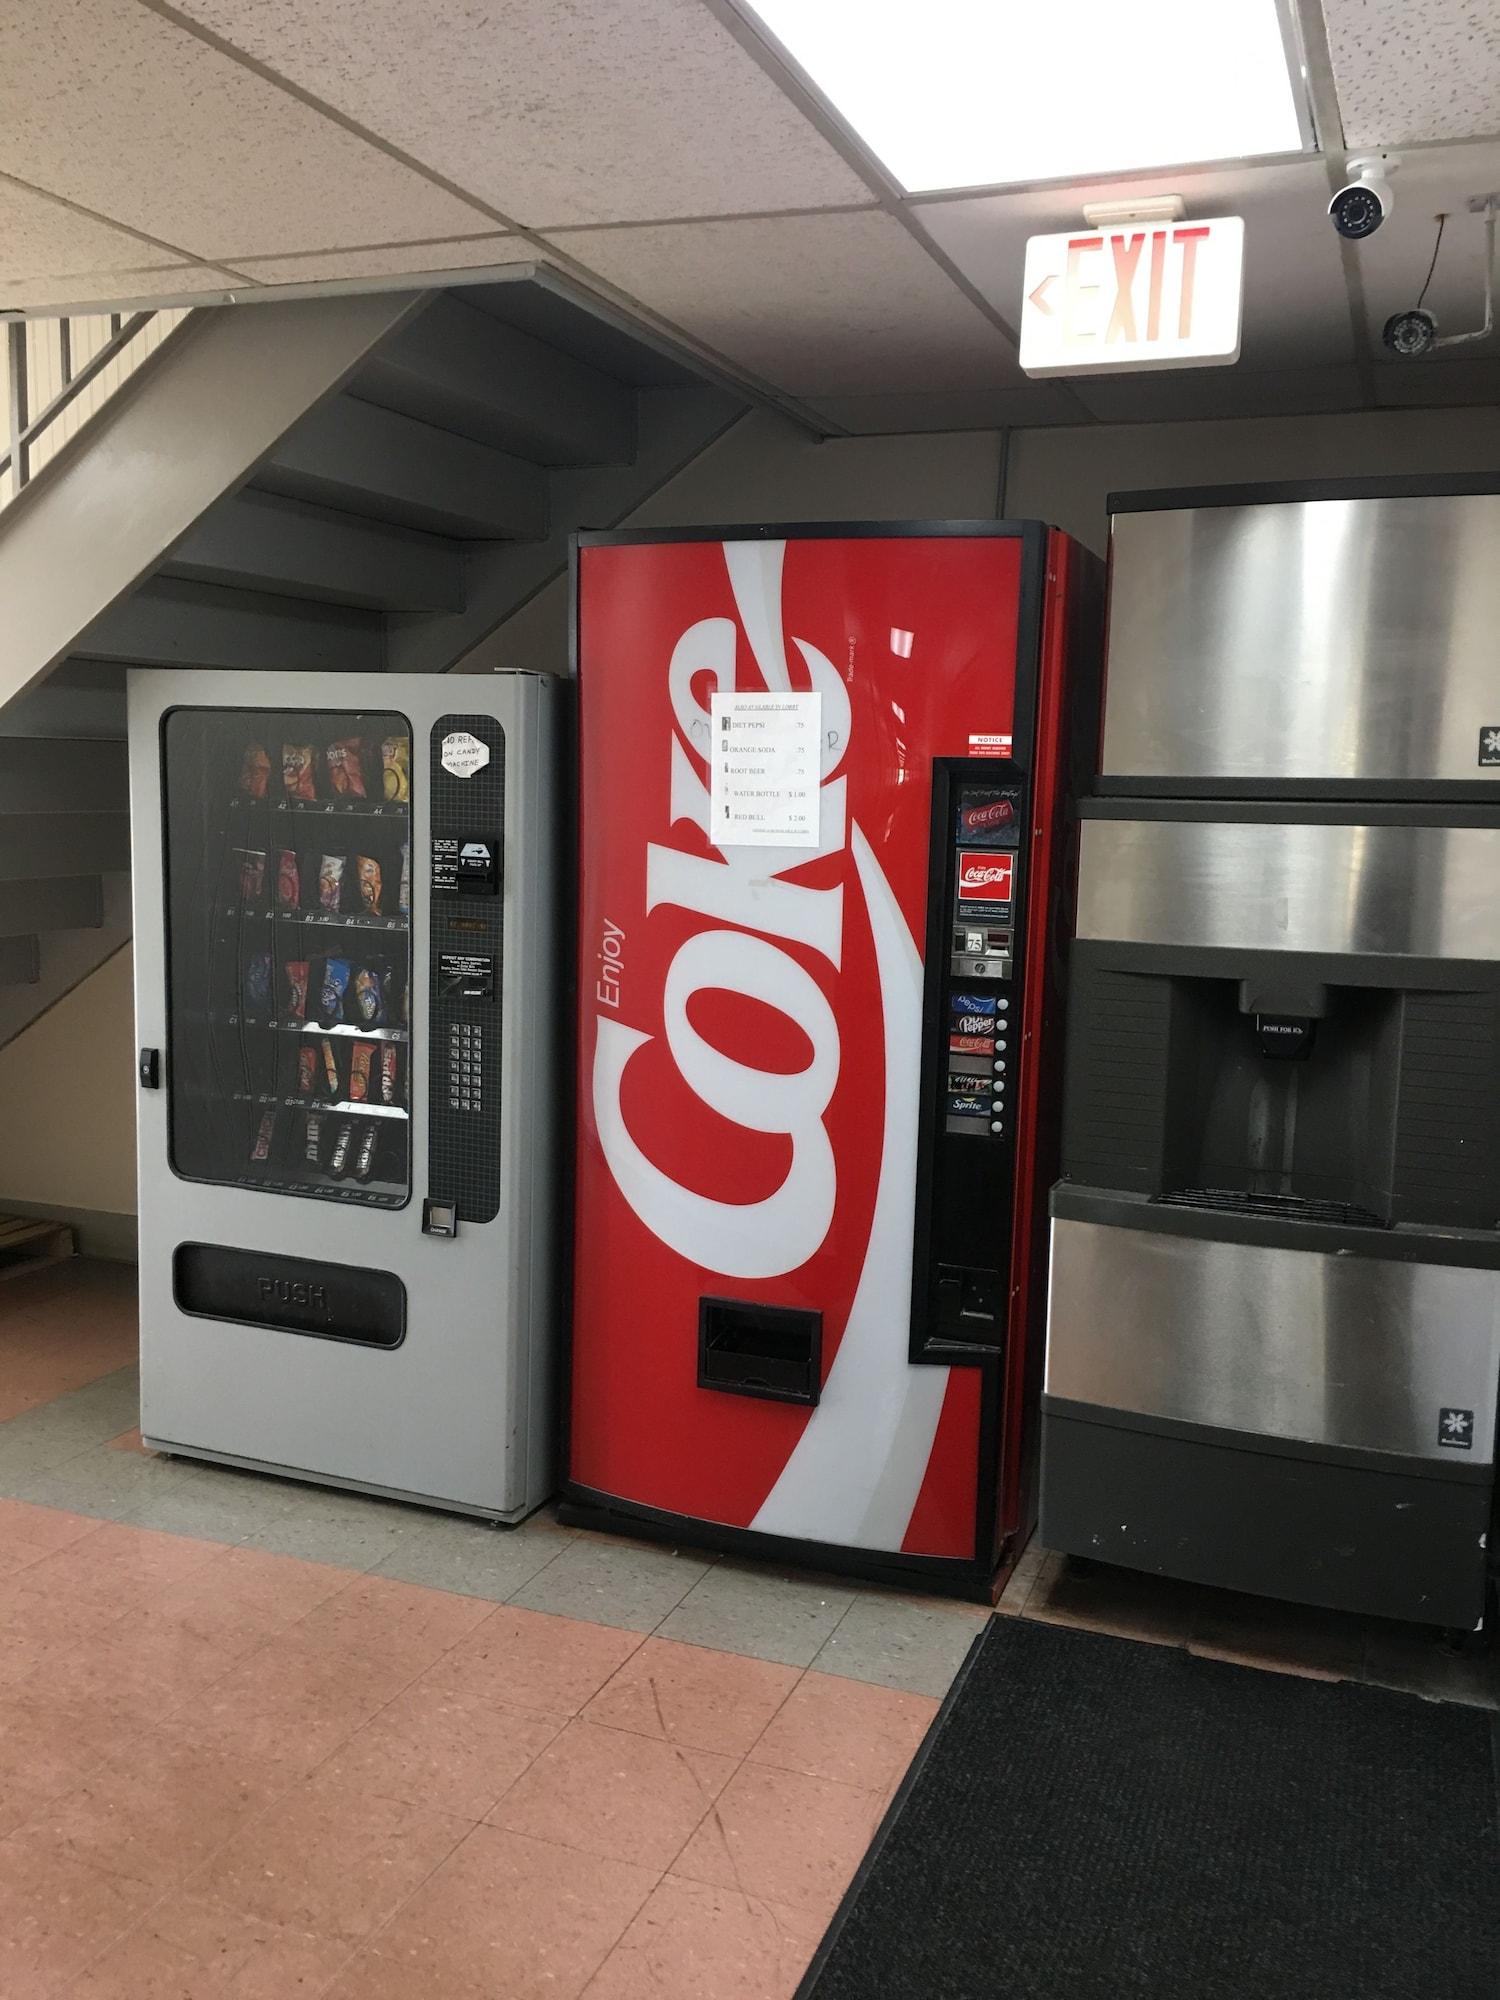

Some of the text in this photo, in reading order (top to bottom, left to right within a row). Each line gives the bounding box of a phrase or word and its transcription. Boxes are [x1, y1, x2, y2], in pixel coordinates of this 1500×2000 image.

[1062, 227, 1210, 345] EXIT
[732, 721, 747, 729] DIET
[748, 721, 766, 729] PEPSI
[443, 736, 455, 745] NO
[456, 747, 480, 755] CANDY
[734, 790, 755, 798] WATER
[756, 790, 780, 798] BOTTLE
[965, 867, 1005, 882] Coca-Cola
[593, 617, 852, 1279] Coke
[968, 938, 981, 950] 75
[597, 918, 626, 1008] Enjoy
[958, 995, 984, 1013] pepsi
[960, 1018, 994, 1033] Pepper
[952, 1098, 982, 1110] Sprite
[257, 1277, 326, 1307] PUSH
